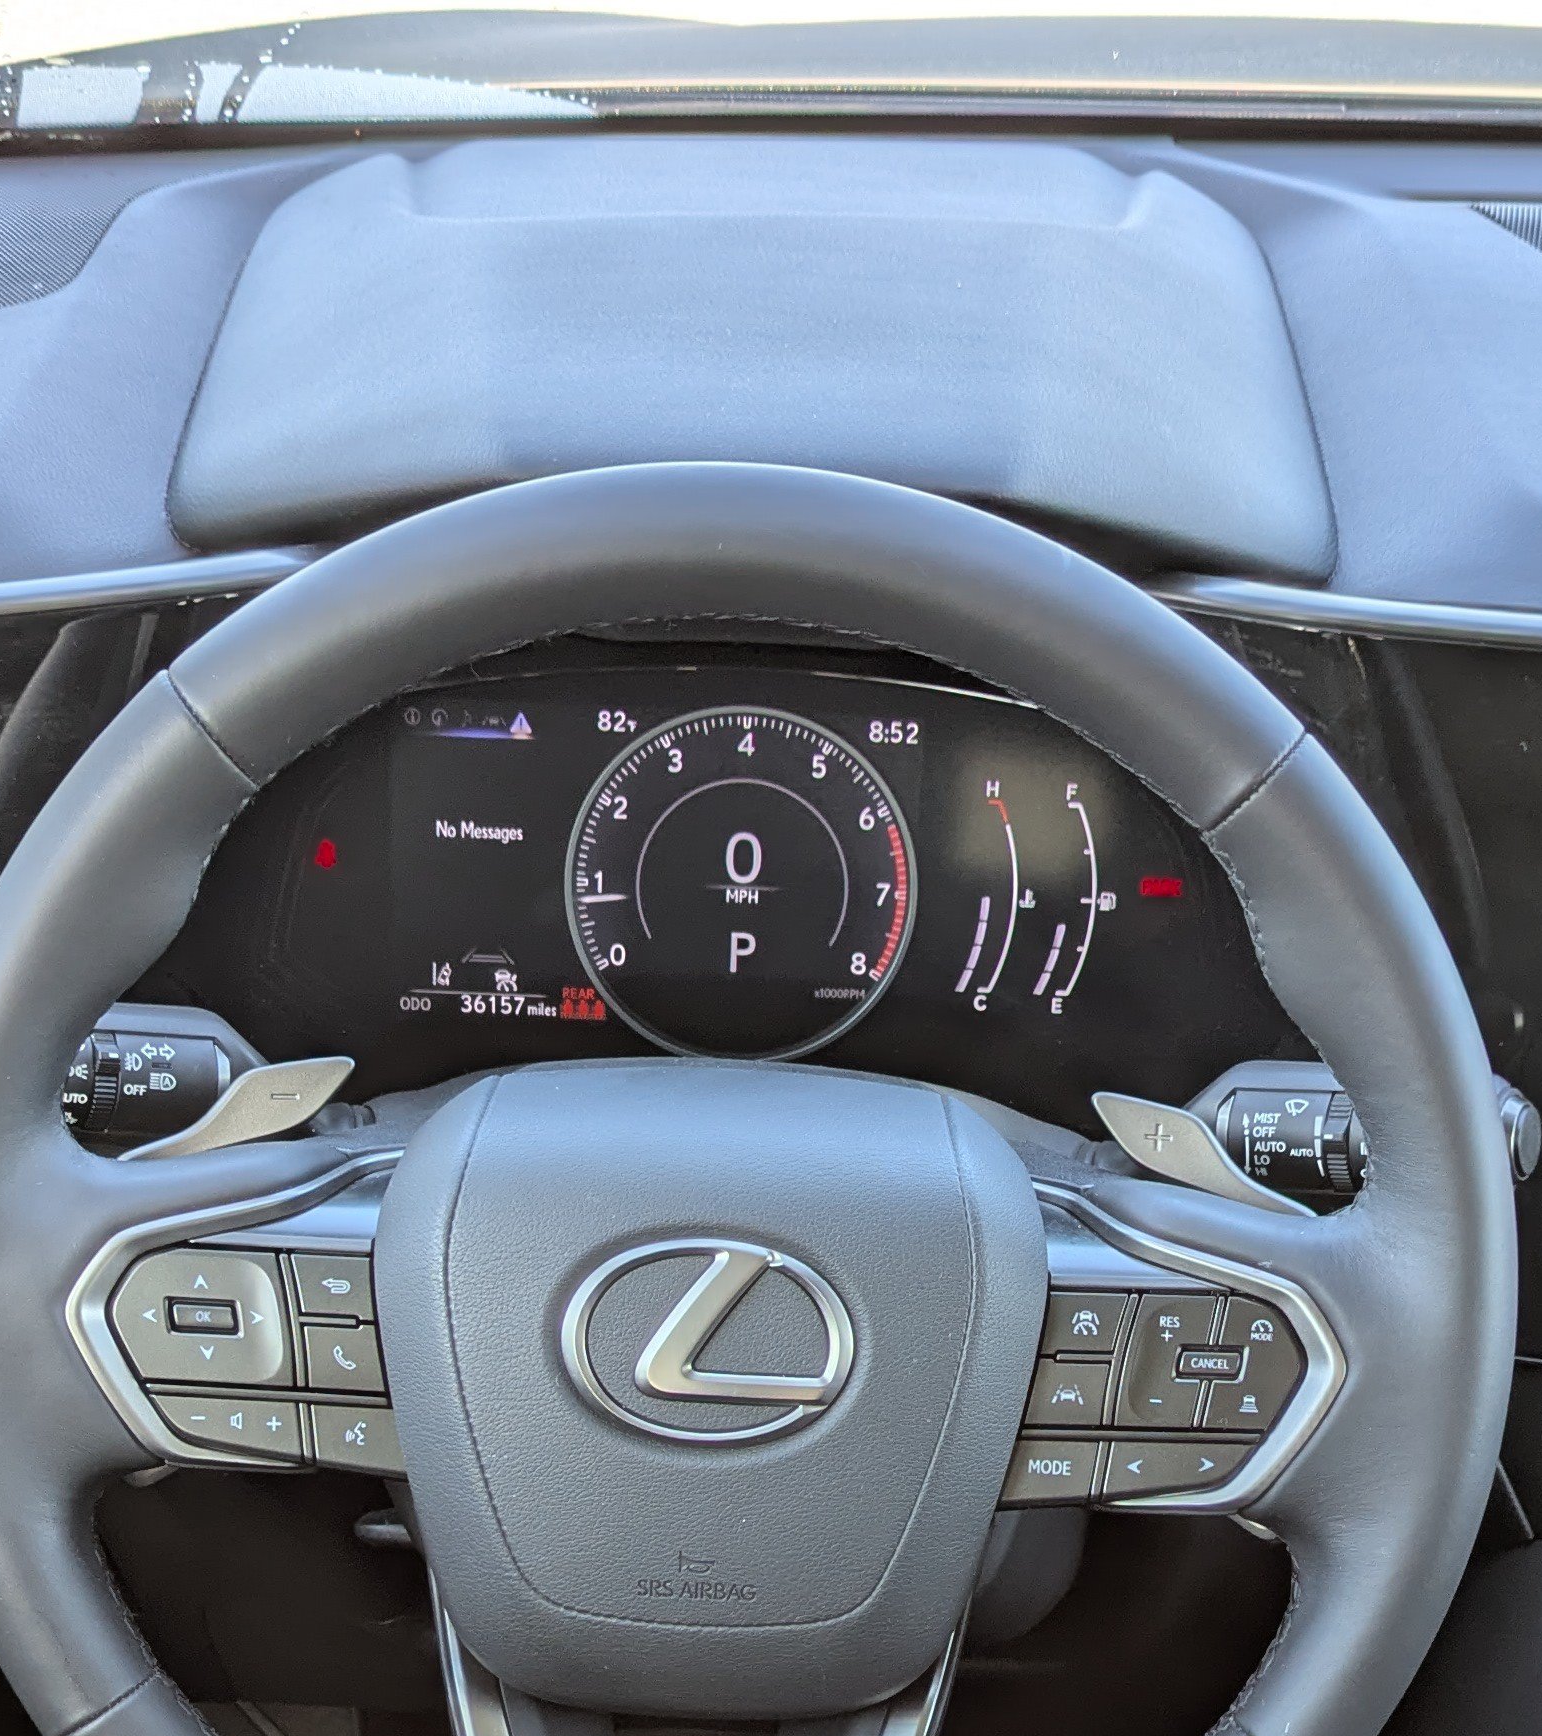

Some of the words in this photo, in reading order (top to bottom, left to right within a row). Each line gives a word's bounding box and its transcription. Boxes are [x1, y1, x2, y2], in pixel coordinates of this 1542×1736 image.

[868, 721, 919, 745] 8:52
[737, 732, 755, 757] 4
[667, 749, 683, 774] 3
[811, 754, 827, 780] 5
[986, 780, 1000, 798] H
[1066, 782, 1078, 800] F
[613, 796, 628, 820] 2
[858, 806, 875, 831] 6
[435, 818, 457, 838] No
[460, 820, 524, 844] Messages
[725, 831, 762, 884] 0
[594, 870, 603, 894] 1
[725, 888, 759, 904] MPH
[876, 882, 891, 907] 7
[609, 943, 626, 966] 0
[729, 932, 756, 973] P
[850, 952, 867, 975] 8
[562, 987, 595, 1000] REAR
[399, 996, 432, 1012] ODO
[460, 994, 525, 1016] 36157
[527, 1003, 557, 1018] miles
[973, 994, 987, 1012] C
[1051, 997, 1063, 1015] E
[123, 1083, 148, 1097] OFF
[1253, 1112, 1282, 1124] MIST
[1252, 1126, 1277, 1138] OFF
[1254, 1141, 1287, 1153] AUTO
[1289, 1148, 1314, 1158] AUTO
[1253, 1154, 1270, 1166] LO
[195, 1309, 211, 1323] OK
[1159, 1315, 1180, 1328] RES
[1250, 1332, 1274, 1342] MODE
[1190, 1357, 1229, 1370] CANCEL
[1027, 1459, 1072, 1476] MODE
[636, 1579, 674, 1598] SRS
[678, 1581, 757, 1601] AIRBAG
